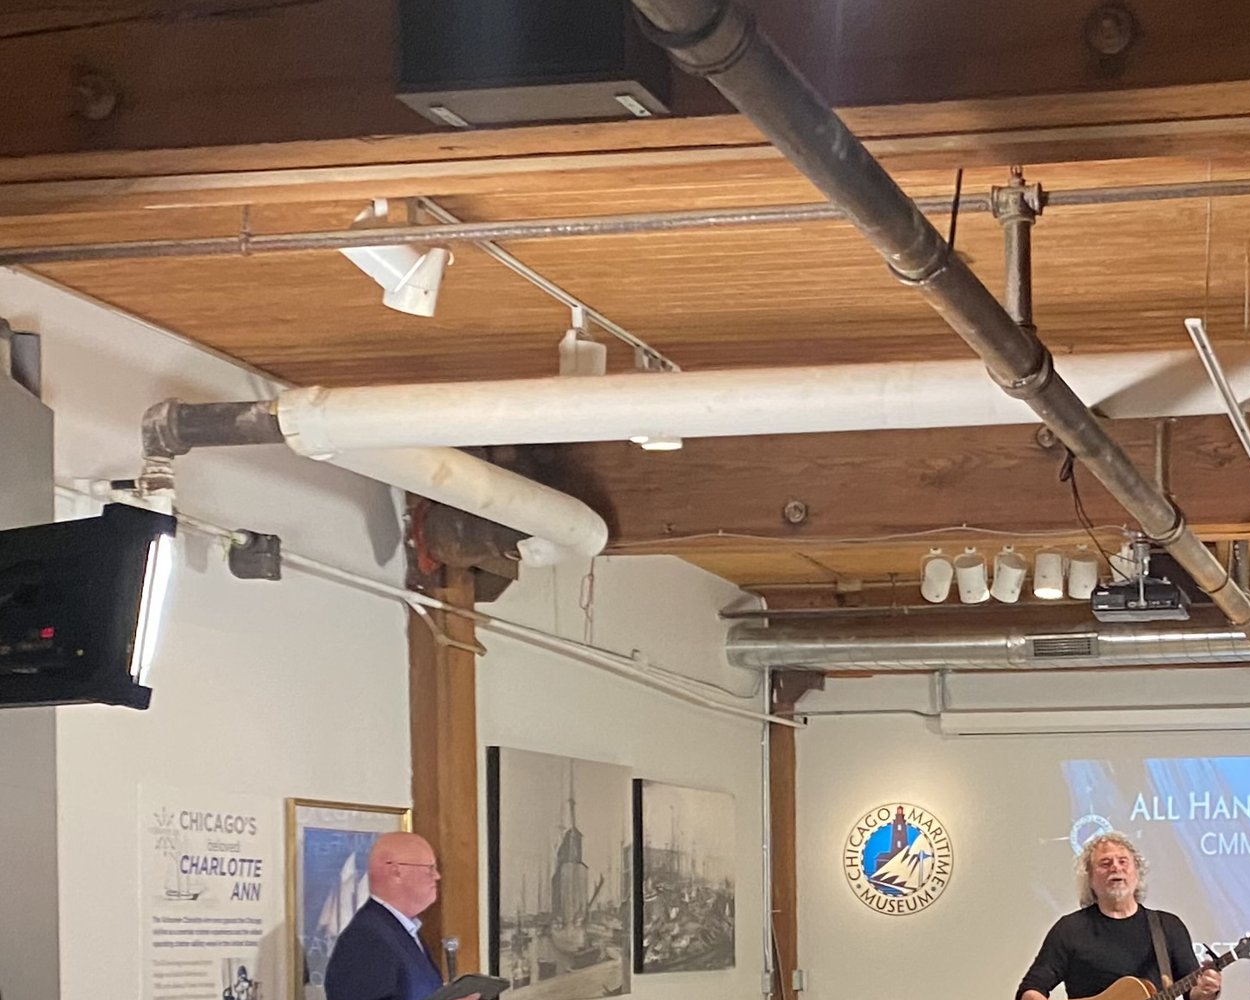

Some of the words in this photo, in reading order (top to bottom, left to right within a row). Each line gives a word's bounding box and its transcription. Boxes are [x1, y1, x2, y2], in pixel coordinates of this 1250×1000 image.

[1129, 792, 1180, 821] ALL
[179, 810, 257, 836] CHICAGO'S
[845, 807, 891, 881] CHICAGO
[907, 808, 951, 888] MARITIME
[179, 854, 263, 878] CHARLOTTE
[230, 881, 262, 901] ANN
[860, 888, 934, 913] MUSEUM
